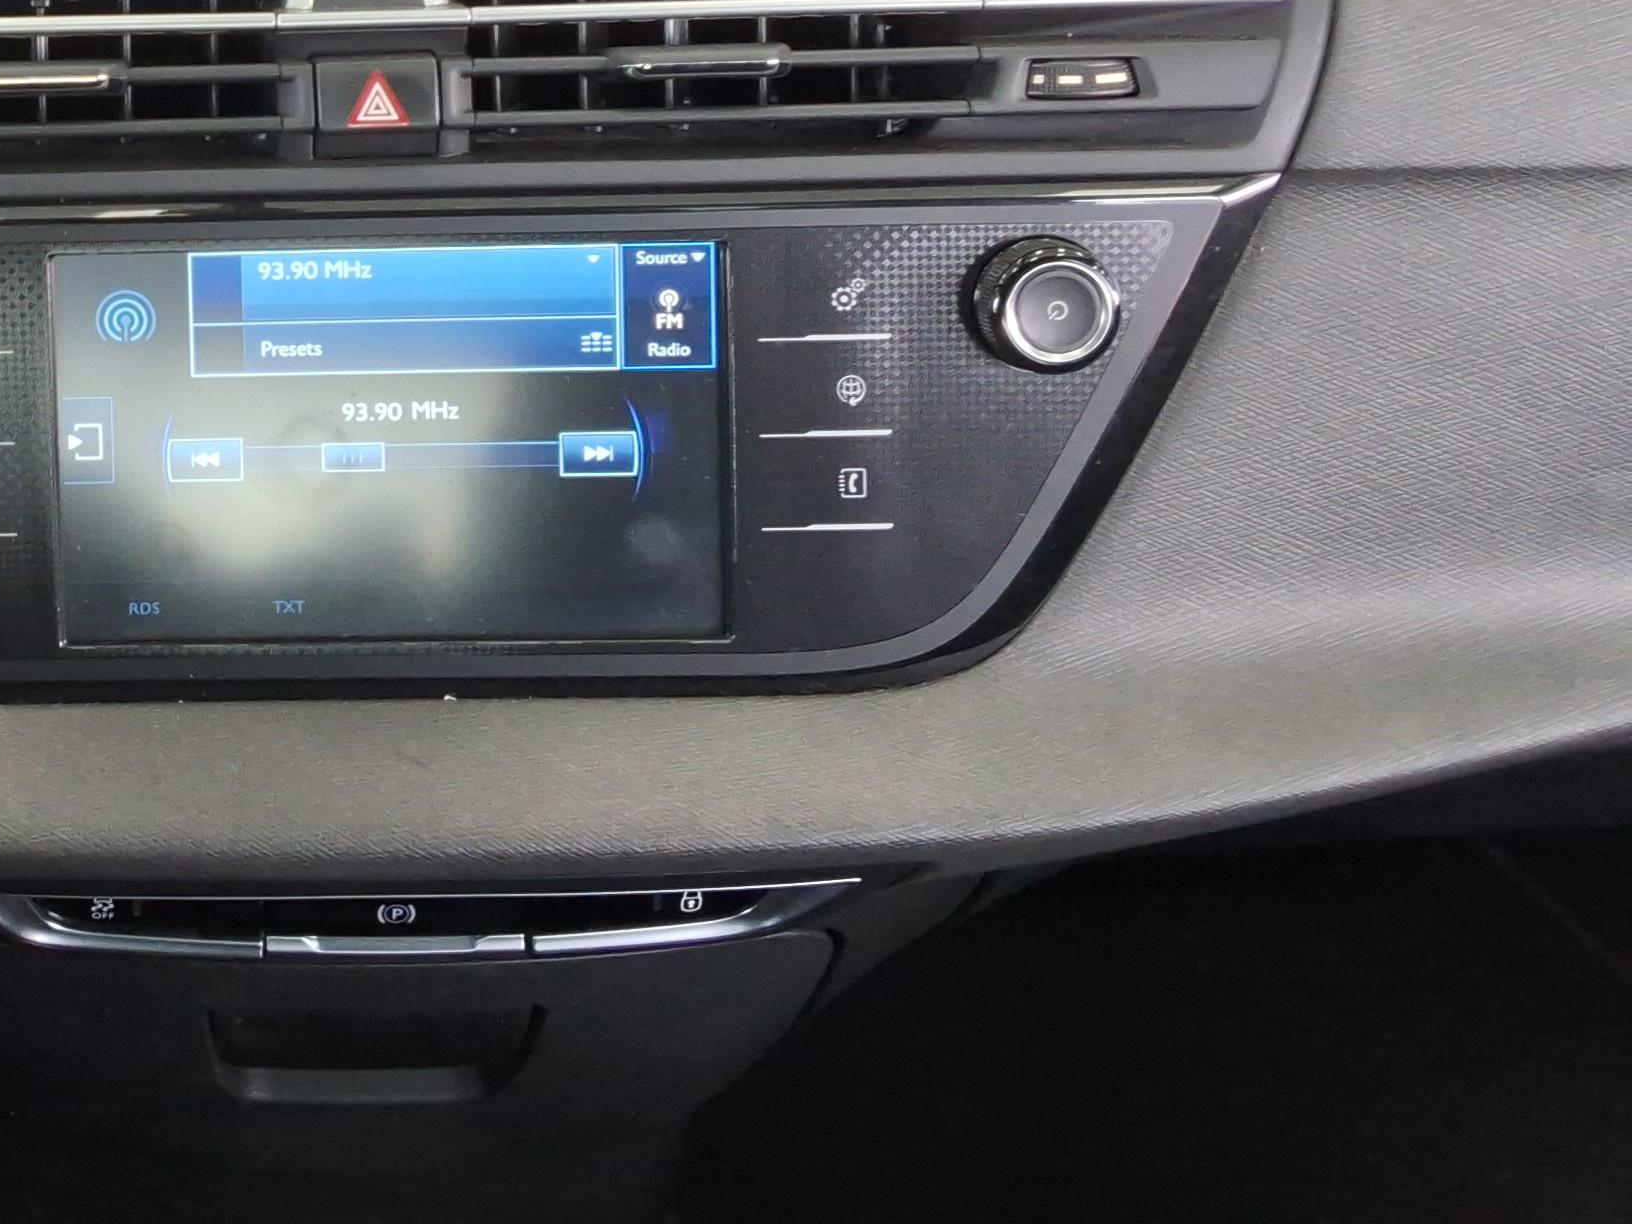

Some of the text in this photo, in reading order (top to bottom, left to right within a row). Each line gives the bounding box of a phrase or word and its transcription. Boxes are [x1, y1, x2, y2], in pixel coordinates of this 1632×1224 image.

[635, 250, 686, 266] Source
[258, 261, 373, 281] 93.90 MHz
[655, 313, 683, 330] FM
[260, 340, 323, 359] Presets
[647, 341, 690, 358] Radio
[341, 400, 459, 423] 93.90 MHz
[128, 601, 160, 617] RDS
[274, 600, 304, 615] TXT
